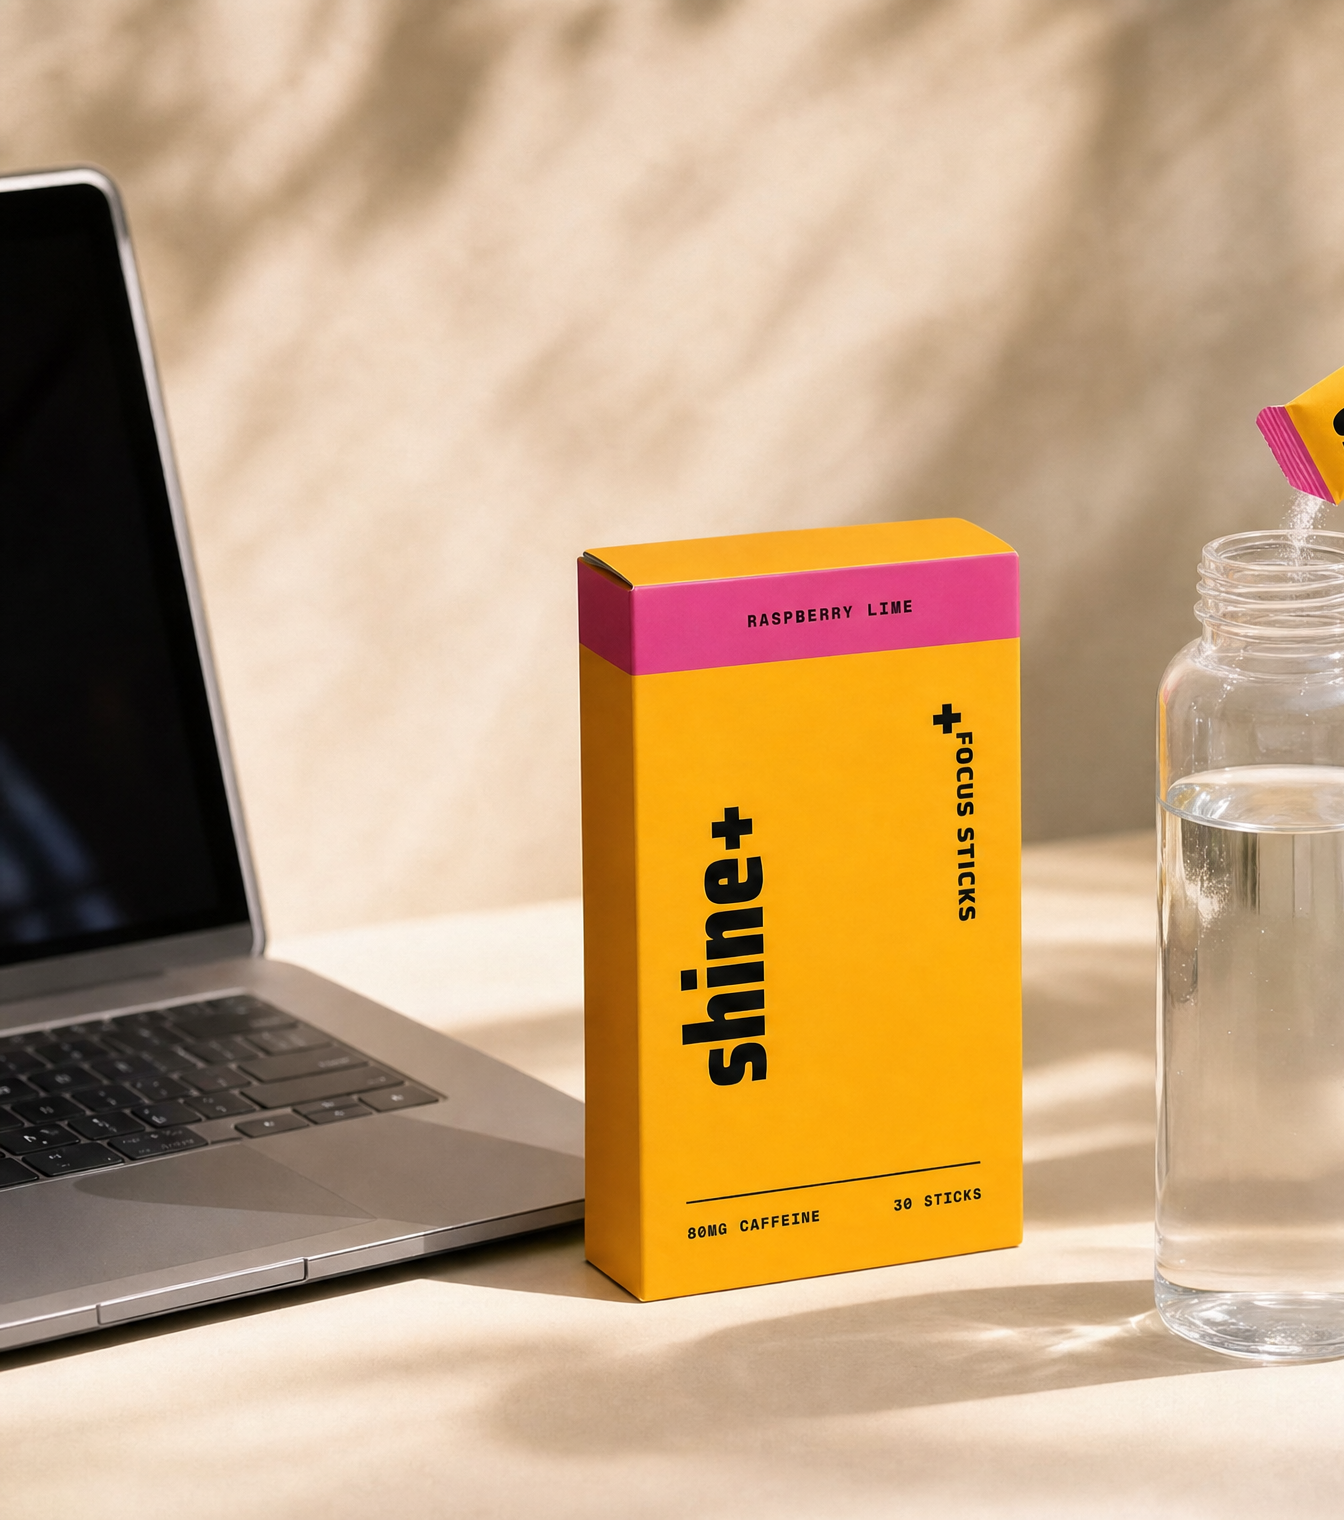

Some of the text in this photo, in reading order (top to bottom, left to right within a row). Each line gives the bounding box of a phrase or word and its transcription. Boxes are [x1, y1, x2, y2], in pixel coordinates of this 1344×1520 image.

[747, 599, 913, 628] RASPBERRY LIME
[956, 827, 977, 922] STICKS
[680, 806, 768, 1087] shine+
[893, 1187, 982, 1212] 30 STICKS
[687, 1210, 820, 1240] 80MG CAFFEINE
